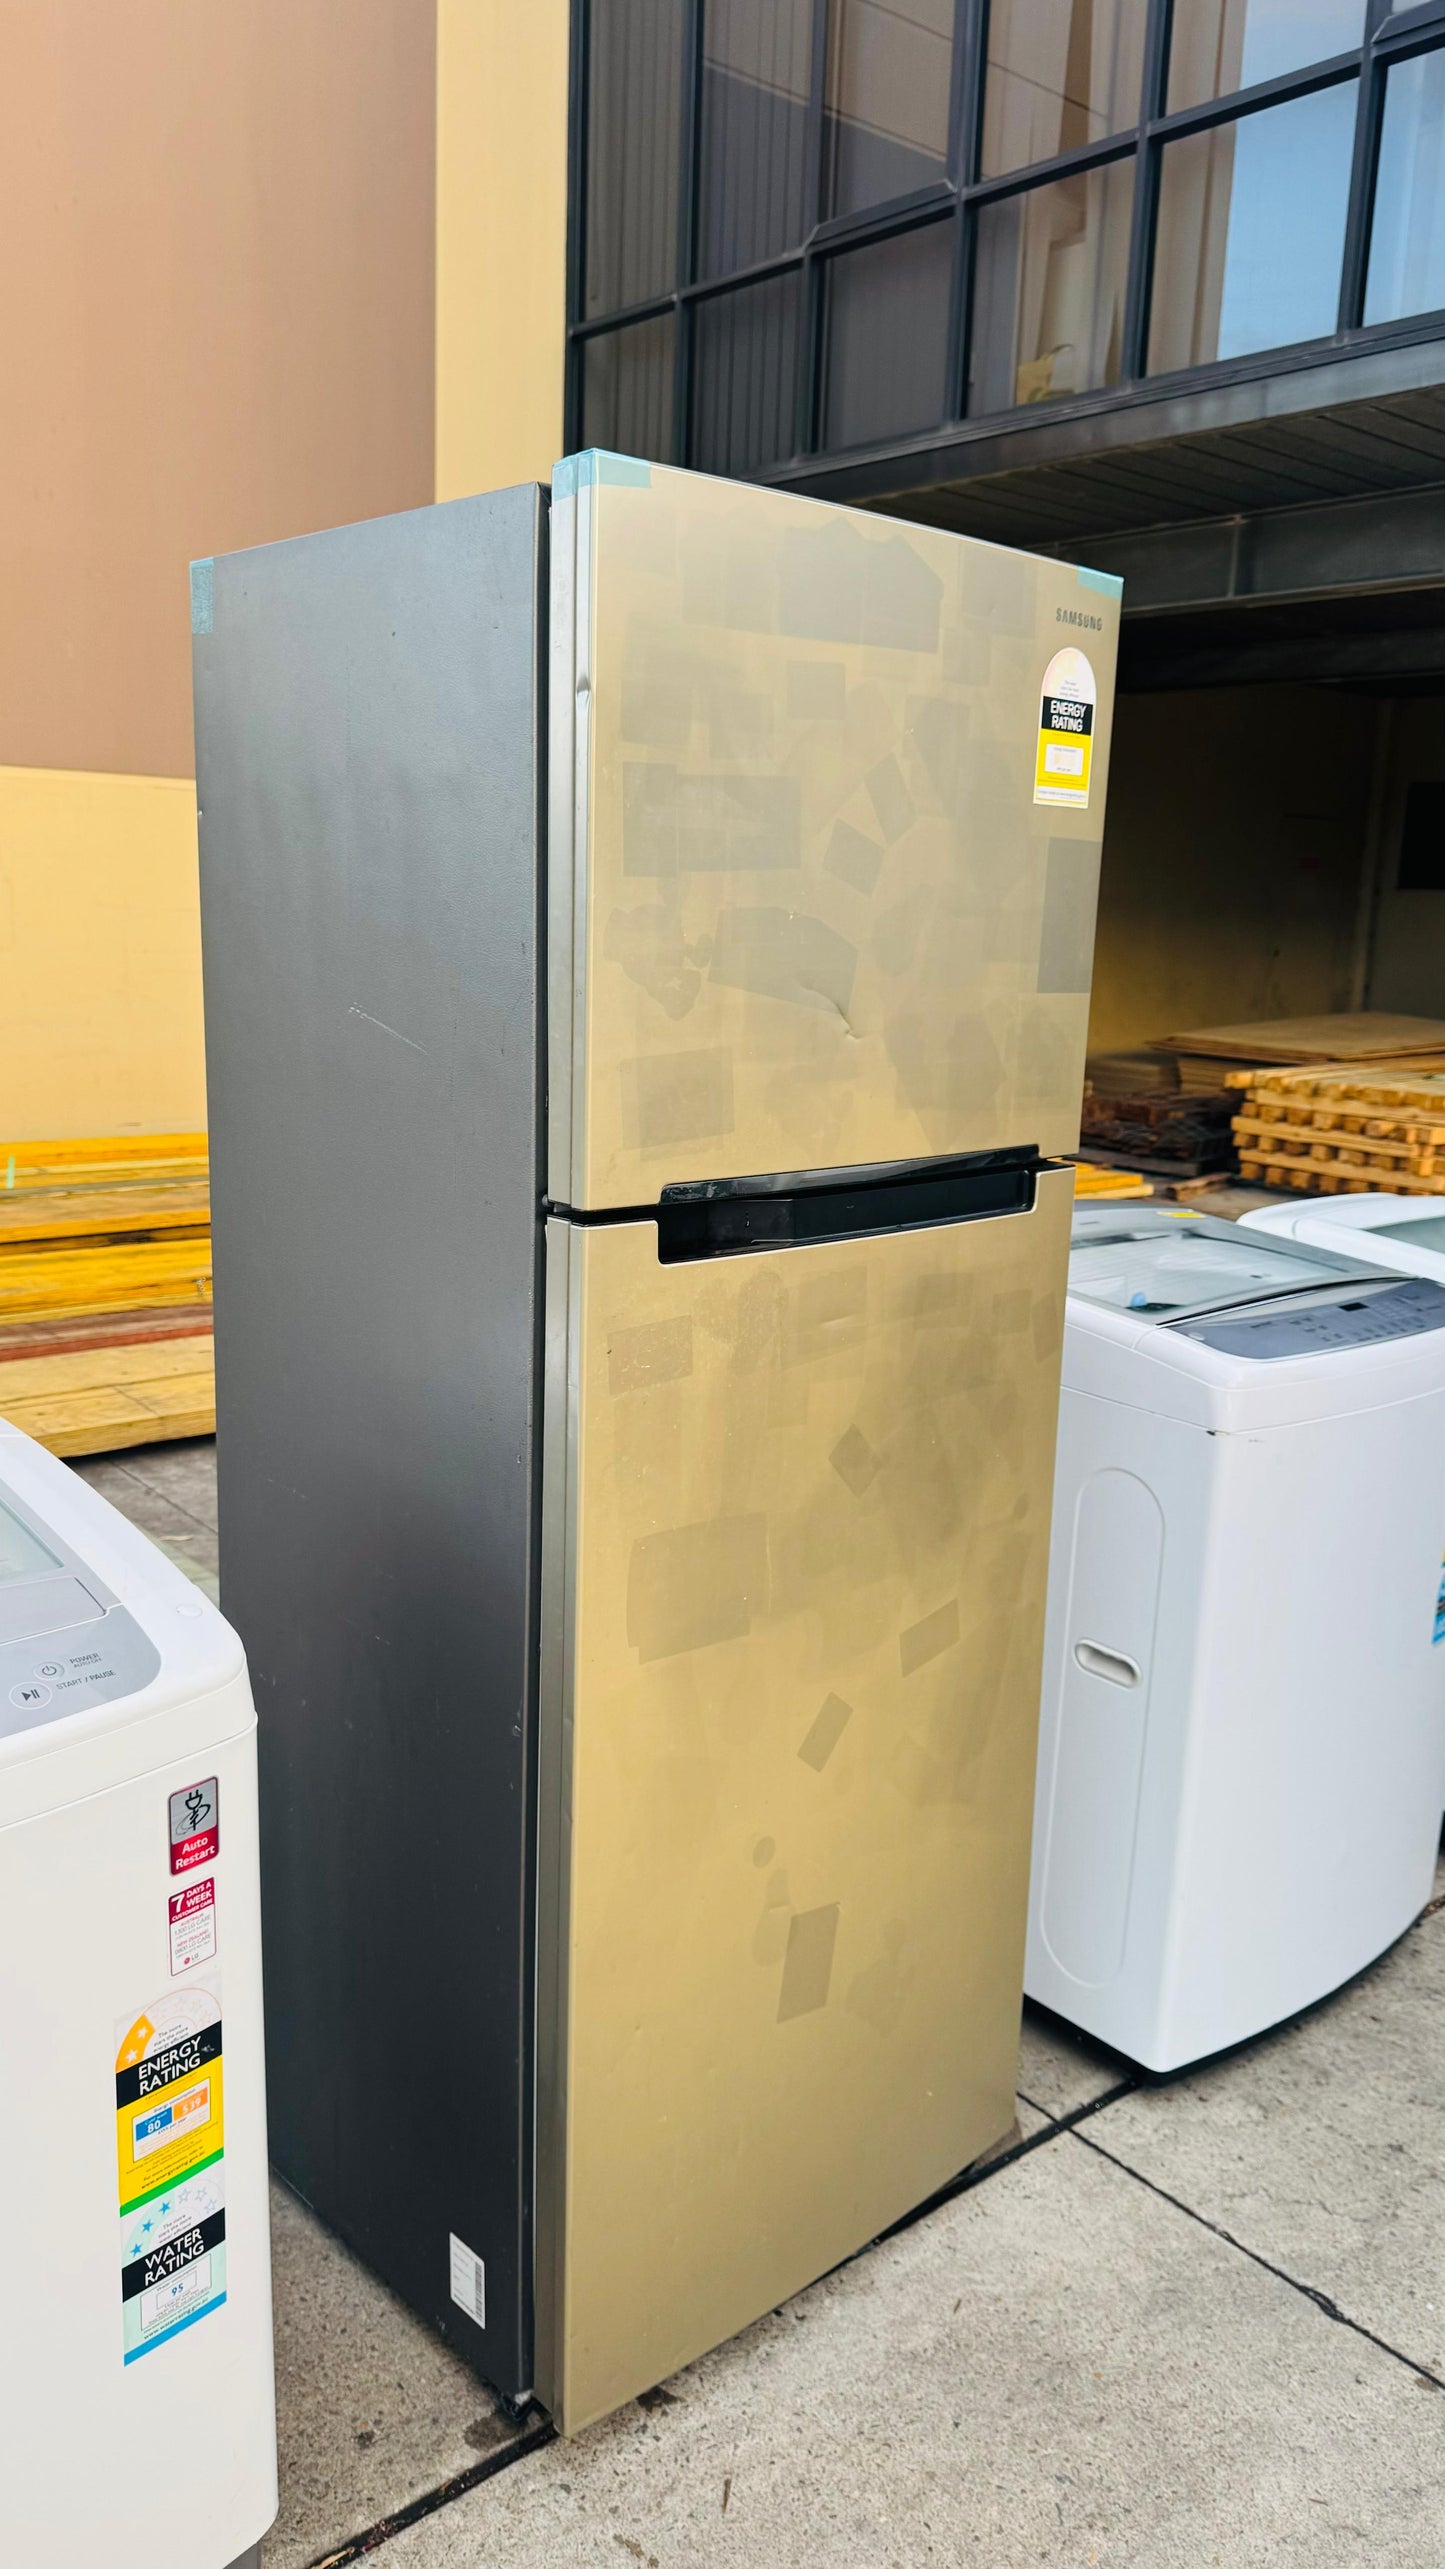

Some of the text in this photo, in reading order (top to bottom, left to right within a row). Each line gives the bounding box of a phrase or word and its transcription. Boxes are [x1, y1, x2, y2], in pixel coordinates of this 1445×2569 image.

[1055, 607, 1103, 631] SAMSUNG
[1050, 700, 1087, 718] ENERGY
[1051, 715, 1083, 732] RATING
[69, 1652, 99, 1664] POWER
[56, 1678, 82, 1689] START
[89, 1670, 116, 1680] PAUSE
[181, 1837, 209, 1855] Auto
[175, 1845, 216, 1870] Restart
[171, 1881, 212, 1913] 7 DAYS A
[186, 1889, 212, 1908] WEEK
[172, 1898, 213, 1922] CUSTOMER CARE
[138, 2035, 201, 2080] ENERGY
[139, 2052, 201, 2096] RATING
[147, 2119, 161, 2133] 80
[145, 2228, 202, 2269] WATER
[145, 2239, 204, 2286] RATING
[171, 2282, 184, 2296] 95
